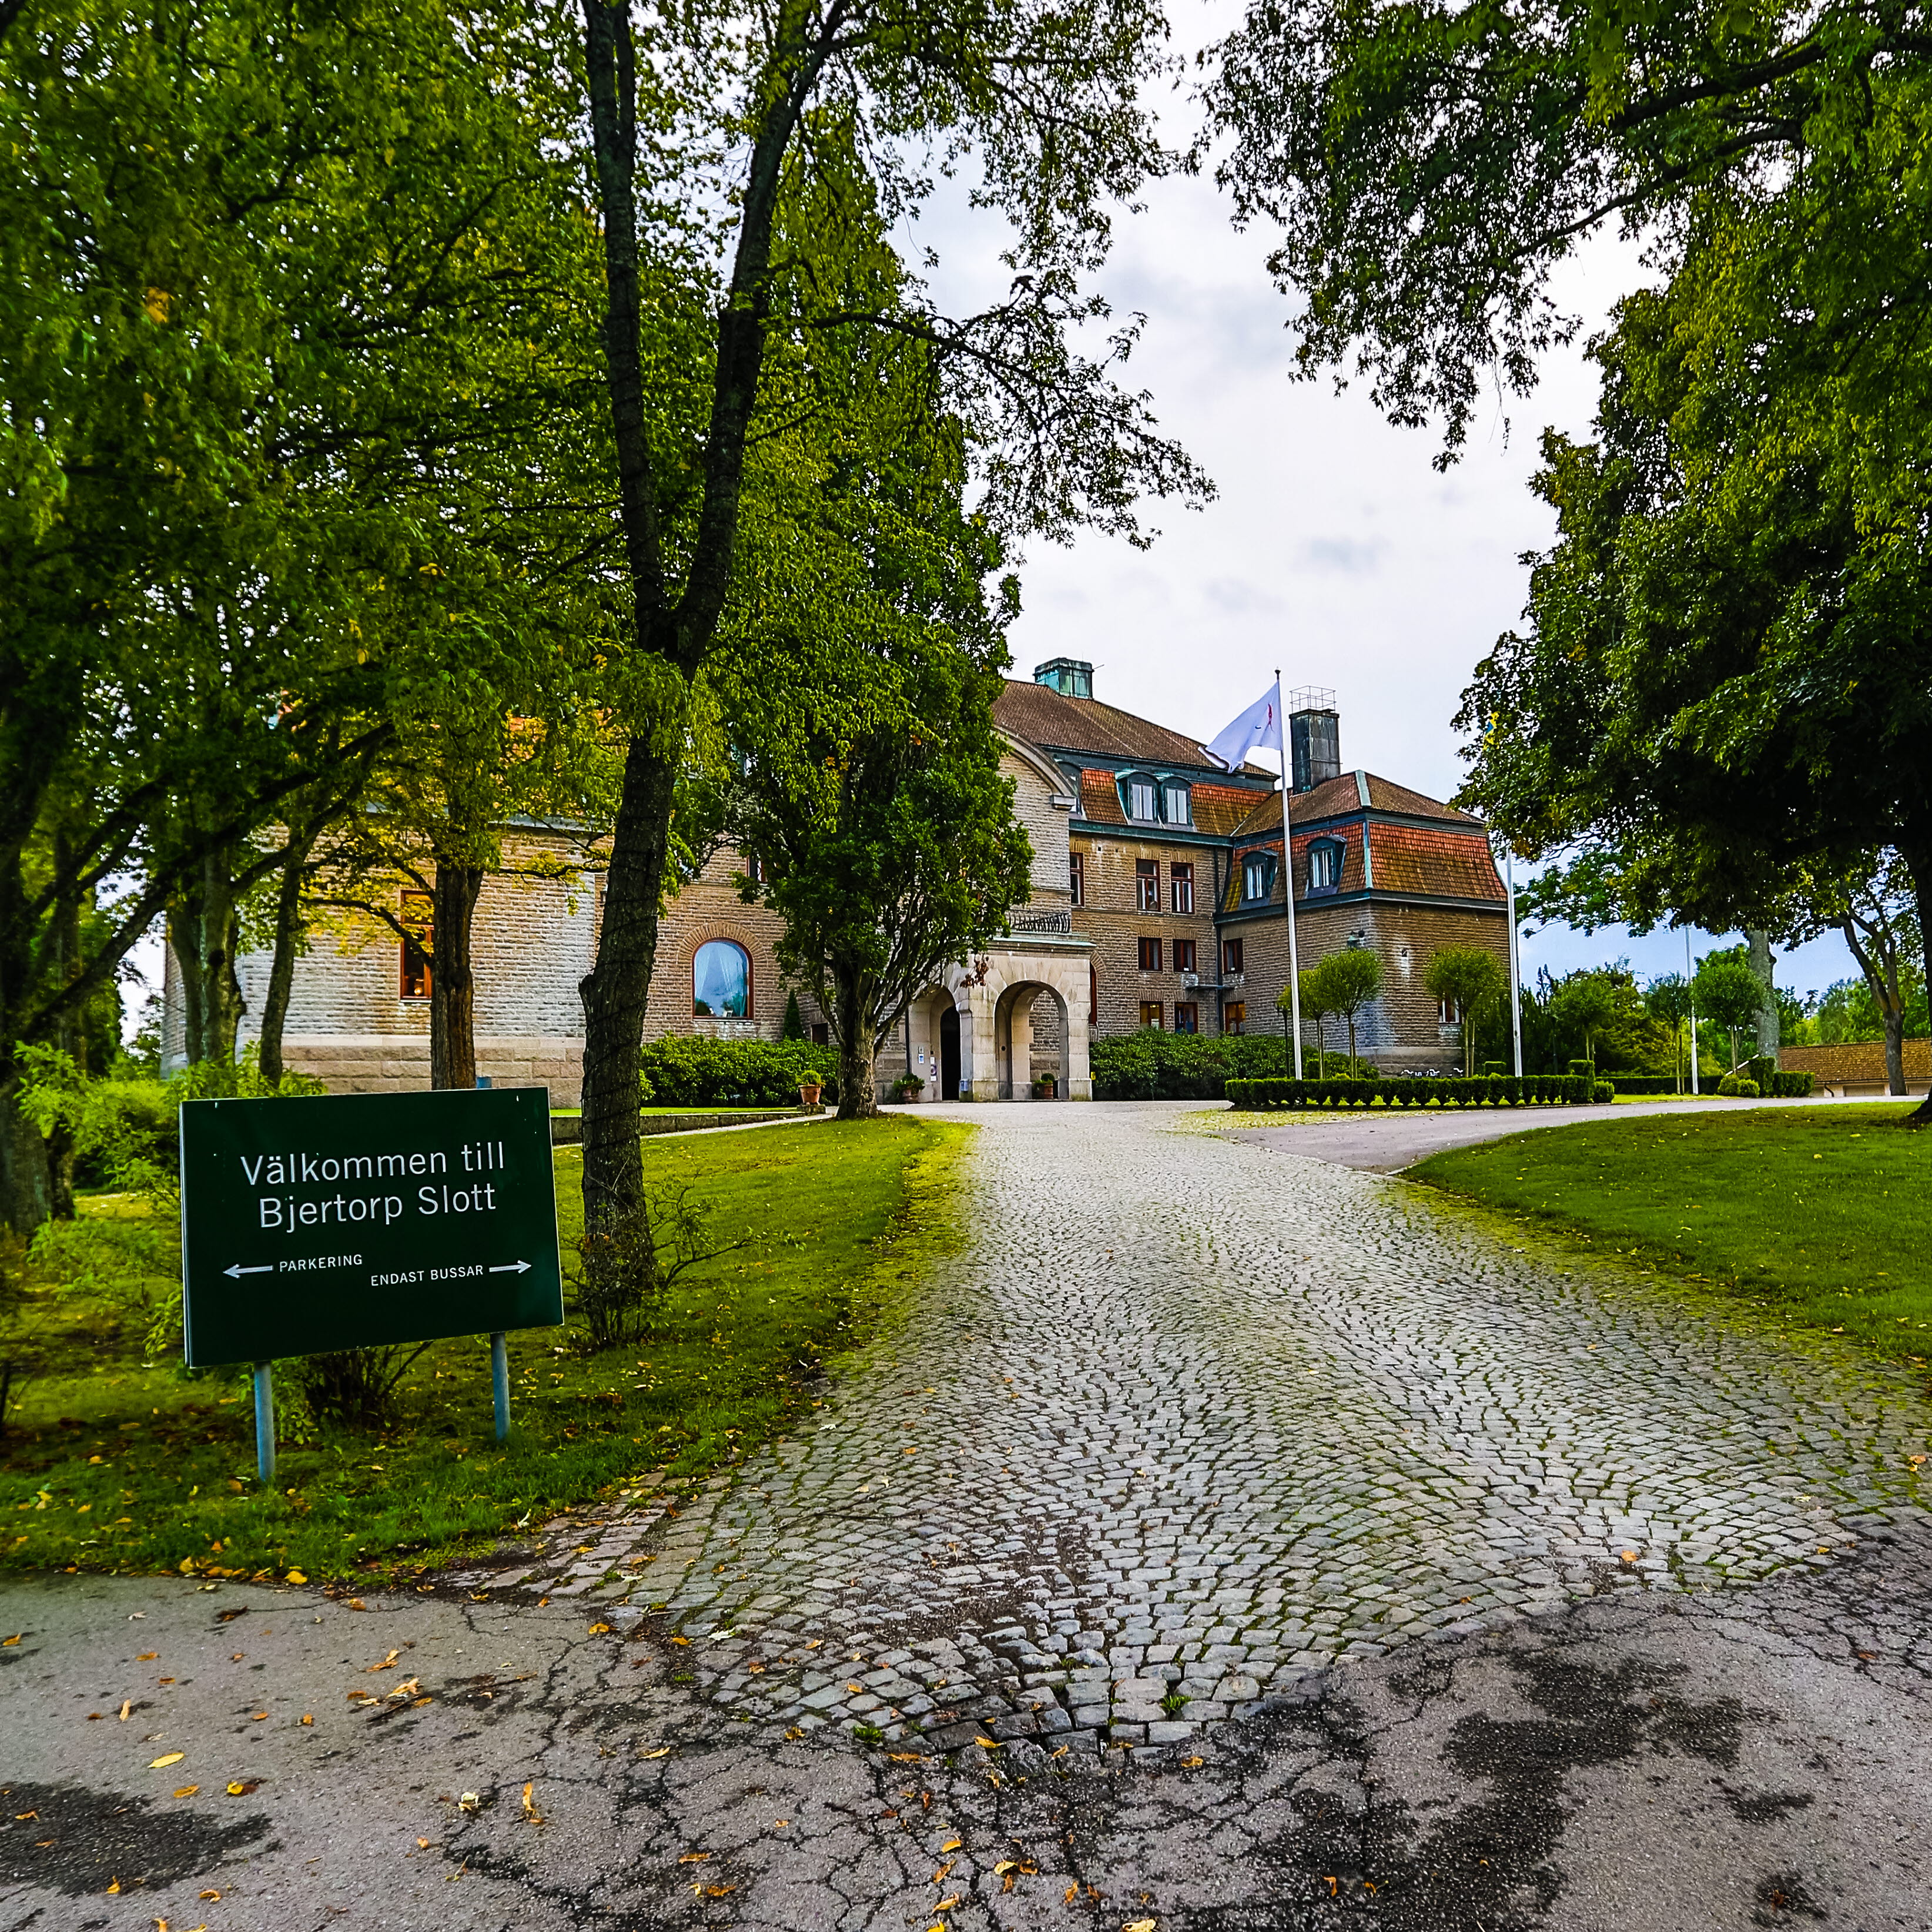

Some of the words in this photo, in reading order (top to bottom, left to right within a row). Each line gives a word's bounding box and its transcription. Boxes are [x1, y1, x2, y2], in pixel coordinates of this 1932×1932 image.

[240, 1151, 446, 1186] Välkommen
[461, 1141, 504, 1171] till
[260, 1194, 403, 1233] Bjertorp
[418, 1183, 496, 1214] Slott
[279, 1254, 362, 1273] PARKERING
[371, 1270, 424, 1286] ENDAST
[430, 1265, 483, 1280] BUSSAR
